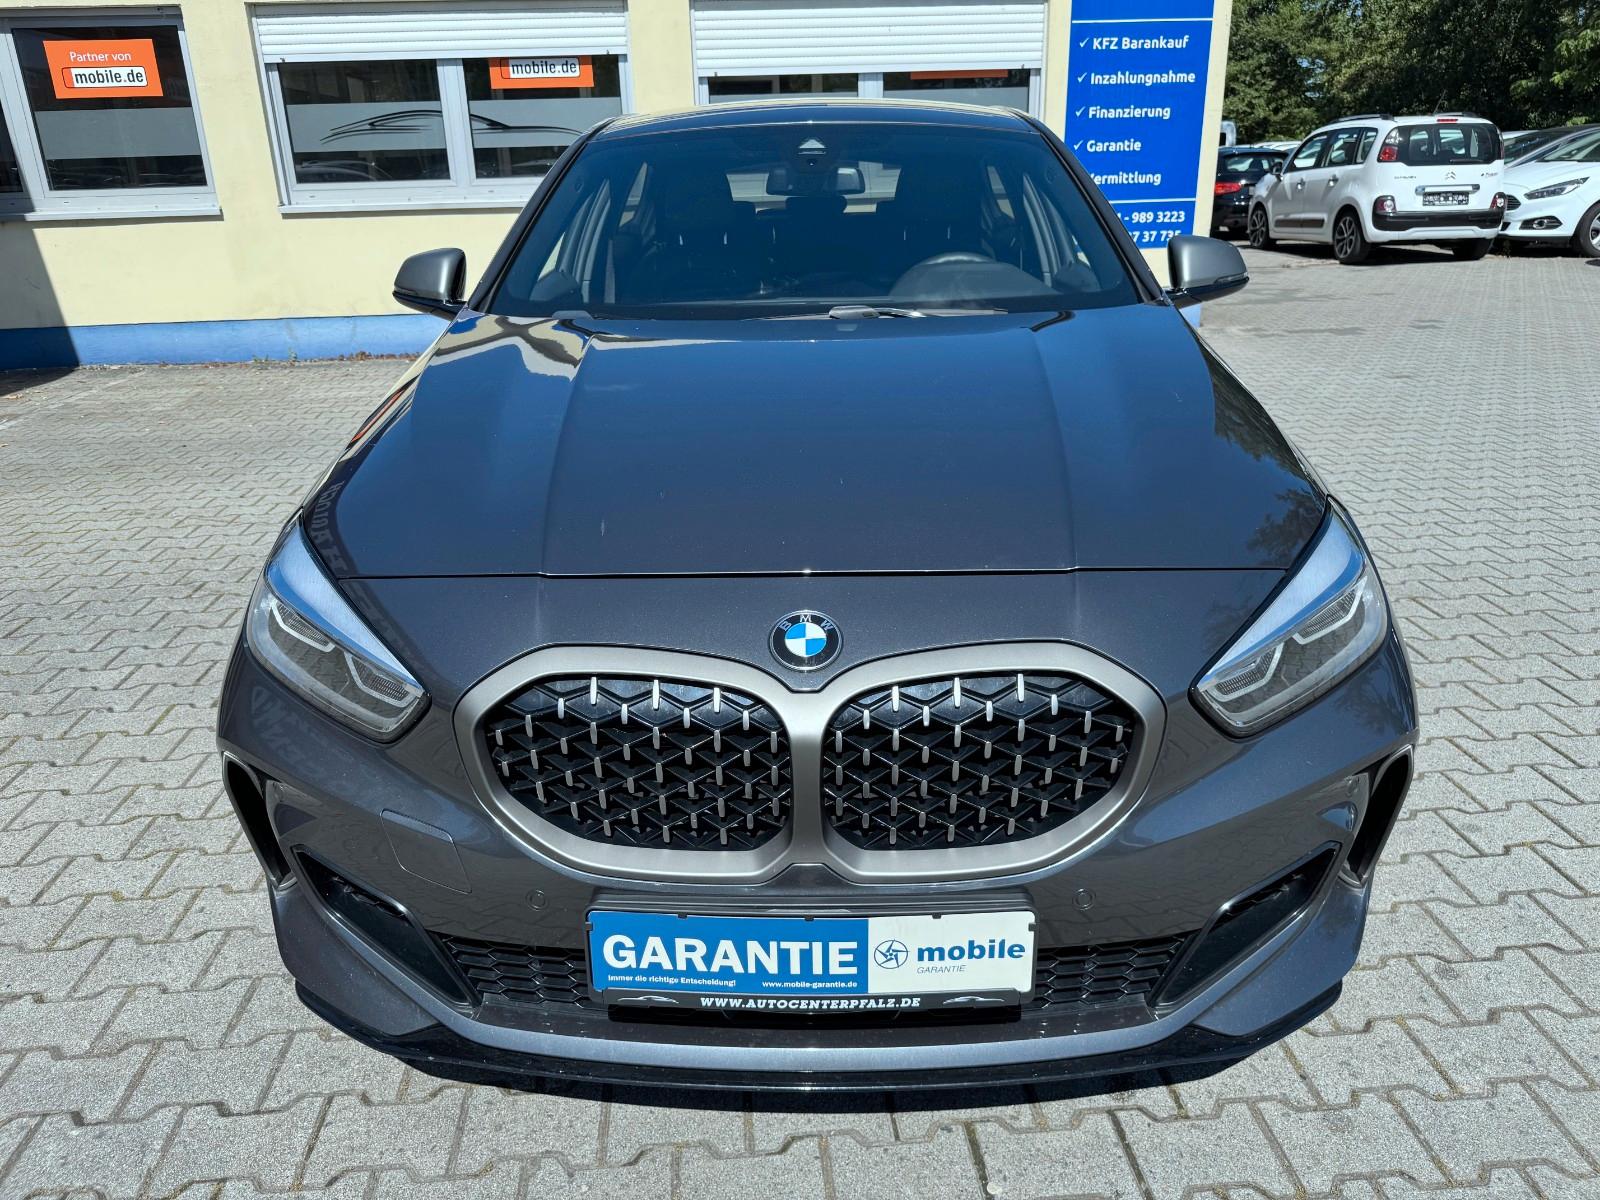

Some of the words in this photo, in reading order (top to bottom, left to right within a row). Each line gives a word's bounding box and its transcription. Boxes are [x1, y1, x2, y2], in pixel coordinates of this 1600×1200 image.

[1092, 38, 1118, 50] KFZ
[1121, 35, 1190, 50] Barankauf
[69, 51, 109, 62] Partner
[112, 53, 132, 61] von
[511, 60, 577, 75] mobile.de
[74, 69, 144, 84] mobile.de
[1090, 70, 1196, 86] Inzahlungnahme
[1088, 105, 1171, 120] Finanzierung
[1086, 139, 1142, 153] Garantie
[1131, 211, 1154, 223] 989
[1156, 211, 1185, 223] 3223
[1142, 230, 1157, 243] 37
[779, 613, 834, 632] BMW
[602, 934, 858, 976] GARANTIE
[917, 939, 1026, 962] mobile
[916, 964, 967, 975] GARANTIE
[607, 974, 634, 983] Immer
[635, 975, 648, 983] die
[649, 976, 679, 986] richtige
[680, 977, 737, 987] Entscheidung!
[761, 980, 858, 989] www.mobile-garantie.de
[699, 997, 921, 1010] WWW.AUTOCENTERPFALZ.DE
